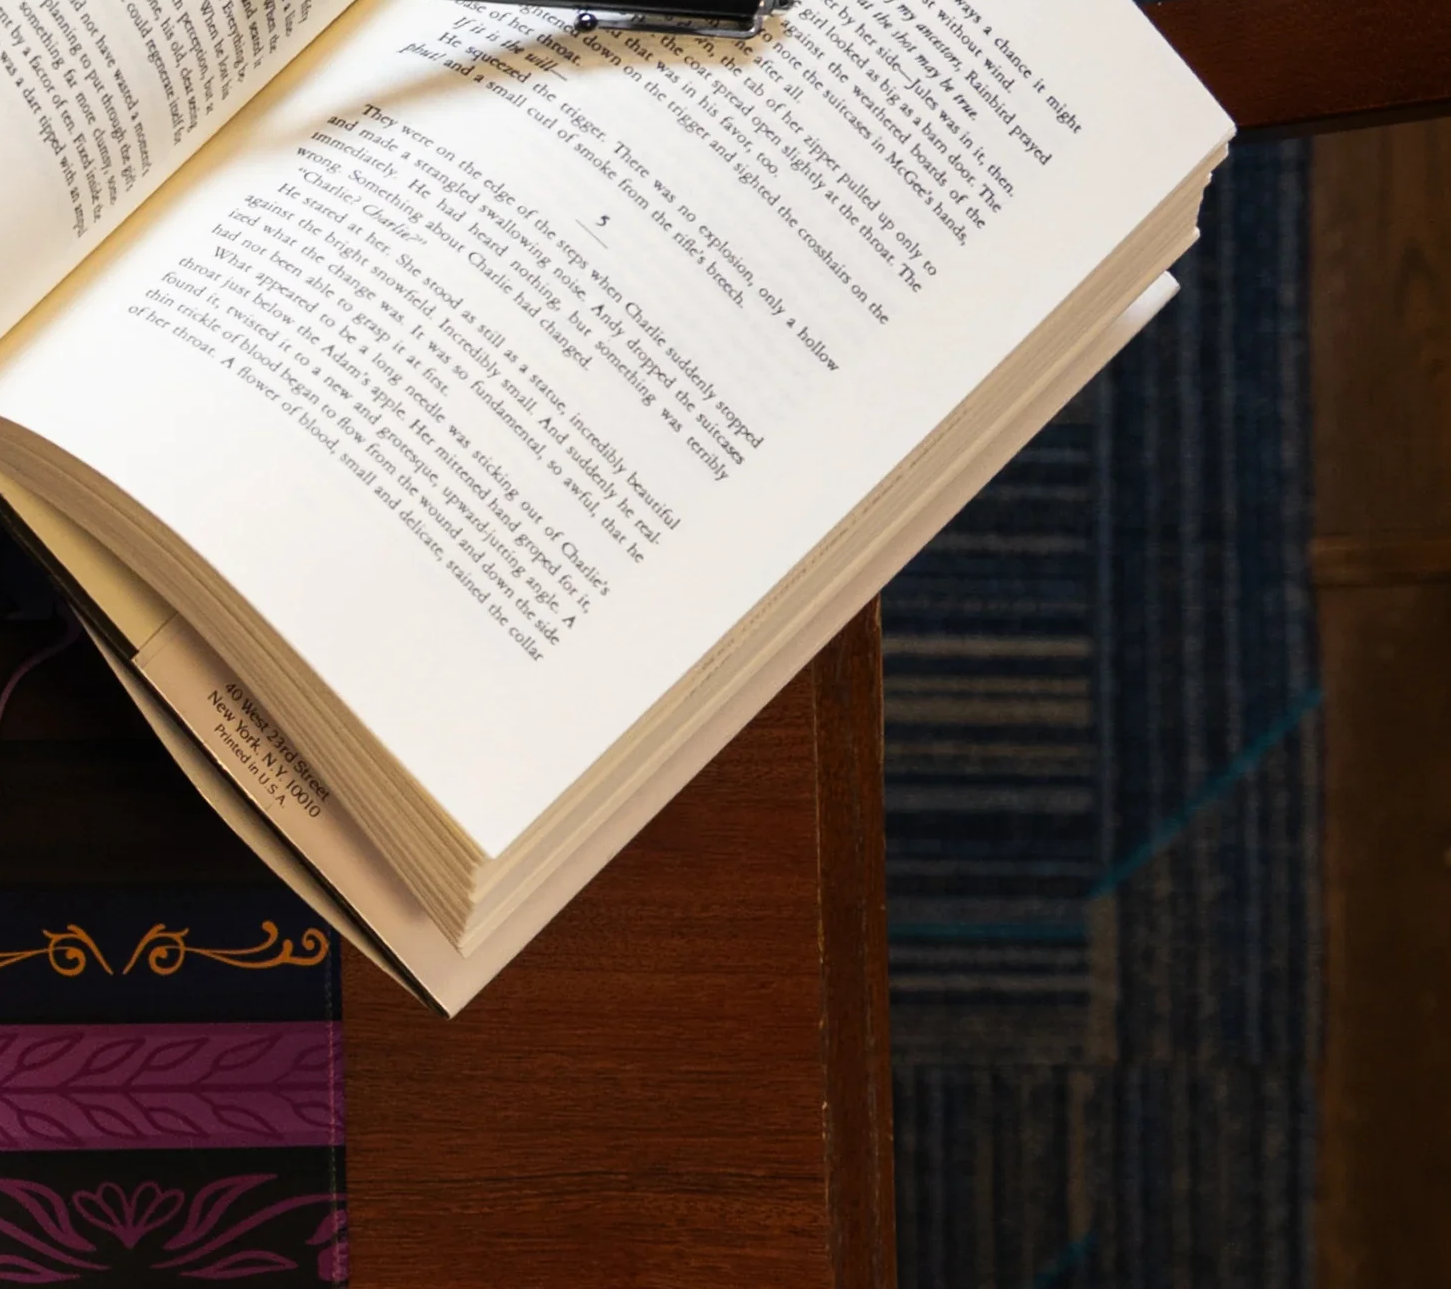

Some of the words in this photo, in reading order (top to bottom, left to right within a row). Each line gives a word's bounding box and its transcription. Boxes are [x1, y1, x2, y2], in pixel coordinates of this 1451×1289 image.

[936, 8, 983, 57] without
[983, 57, 1015, 93] wind.
[982, 25, 992, 36] a
[993, 37, 1032, 79] chance
[1032, 77, 1045, 93] it
[1045, 95, 1081, 134] might
[360, 100, 398, 128] They
[401, 125, 434, 147] were
[435, 146, 455, 161] on
[458, 160, 482, 179] the
[483, 179, 515, 205] edge
[516, 205, 538, 219] of
[534, 218, 556, 239] the
[555, 239, 588, 269] steps
[590, 268, 622, 303] when
[624, 301, 666, 347] Charlie
[664, 347, 716, 400] suddenly
[714, 400, 765, 449] stopped
[595, 214, 610, 227] 5
[127, 305, 149, 316] of
[145, 310, 170, 328] her
[172, 326, 215, 357] throat.
[220, 356, 235, 368] A
[236, 366, 280, 400] flower
[280, 401, 302, 415] of
[297, 411, 339, 454] blood,
[339, 452, 377, 485] small
[373, 485, 402, 510] and
[398, 510, 443, 561] delicate,
[445, 559, 491, 604] stained
[487, 603, 508, 626] the
[508, 626, 543, 661] collar
[206, 689, 235, 721] New
[284, 779, 320, 817] 10010
[213, 722, 251, 764] Printed
[247, 761, 259, 775] in
[257, 772, 285, 808] U.S.A.
[225, 683, 243, 701] 40
[241, 697, 268, 732] West
[266, 729, 298, 763] 23rd
[293, 759, 329, 802] Street
